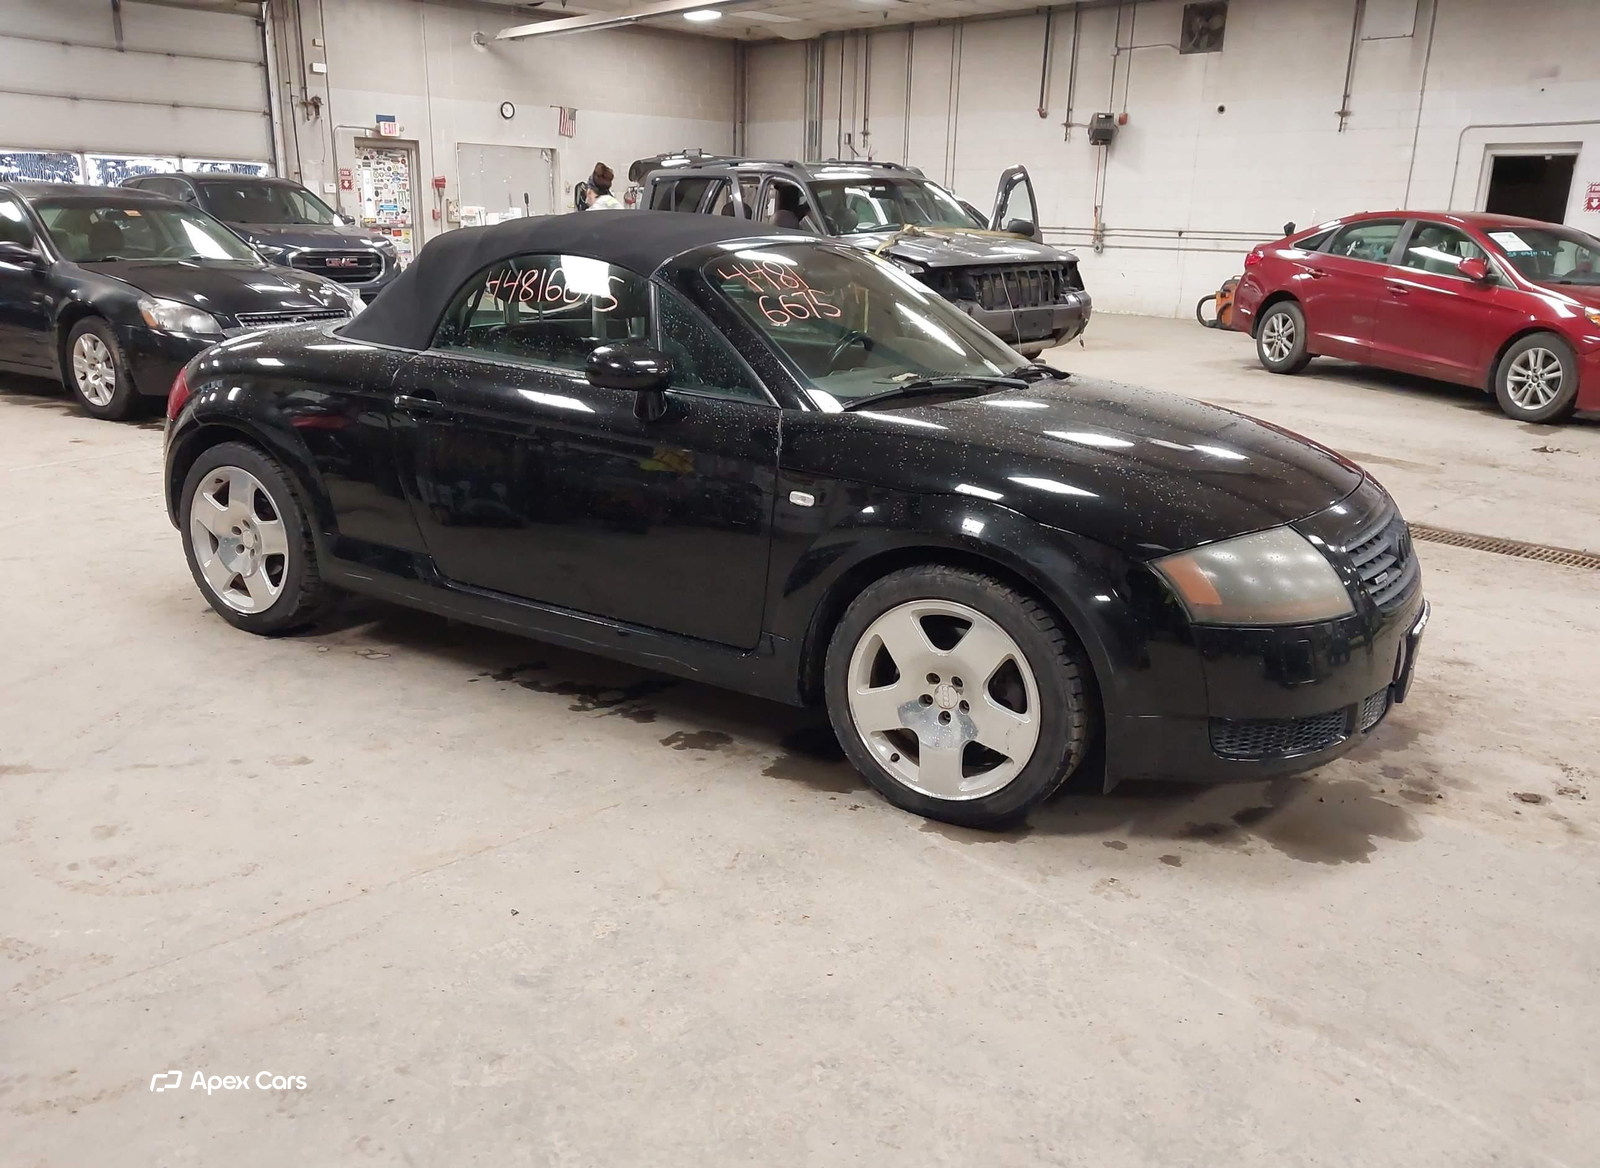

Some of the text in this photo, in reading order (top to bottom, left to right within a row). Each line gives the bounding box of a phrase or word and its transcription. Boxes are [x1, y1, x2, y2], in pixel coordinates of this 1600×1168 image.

[383, 123, 397, 134] EXIT
[325, 257, 359, 268] GMC
[717, 260, 809, 292] 4481
[486, 267, 625, 312] 448165
[759, 289, 841, 325] 6675
